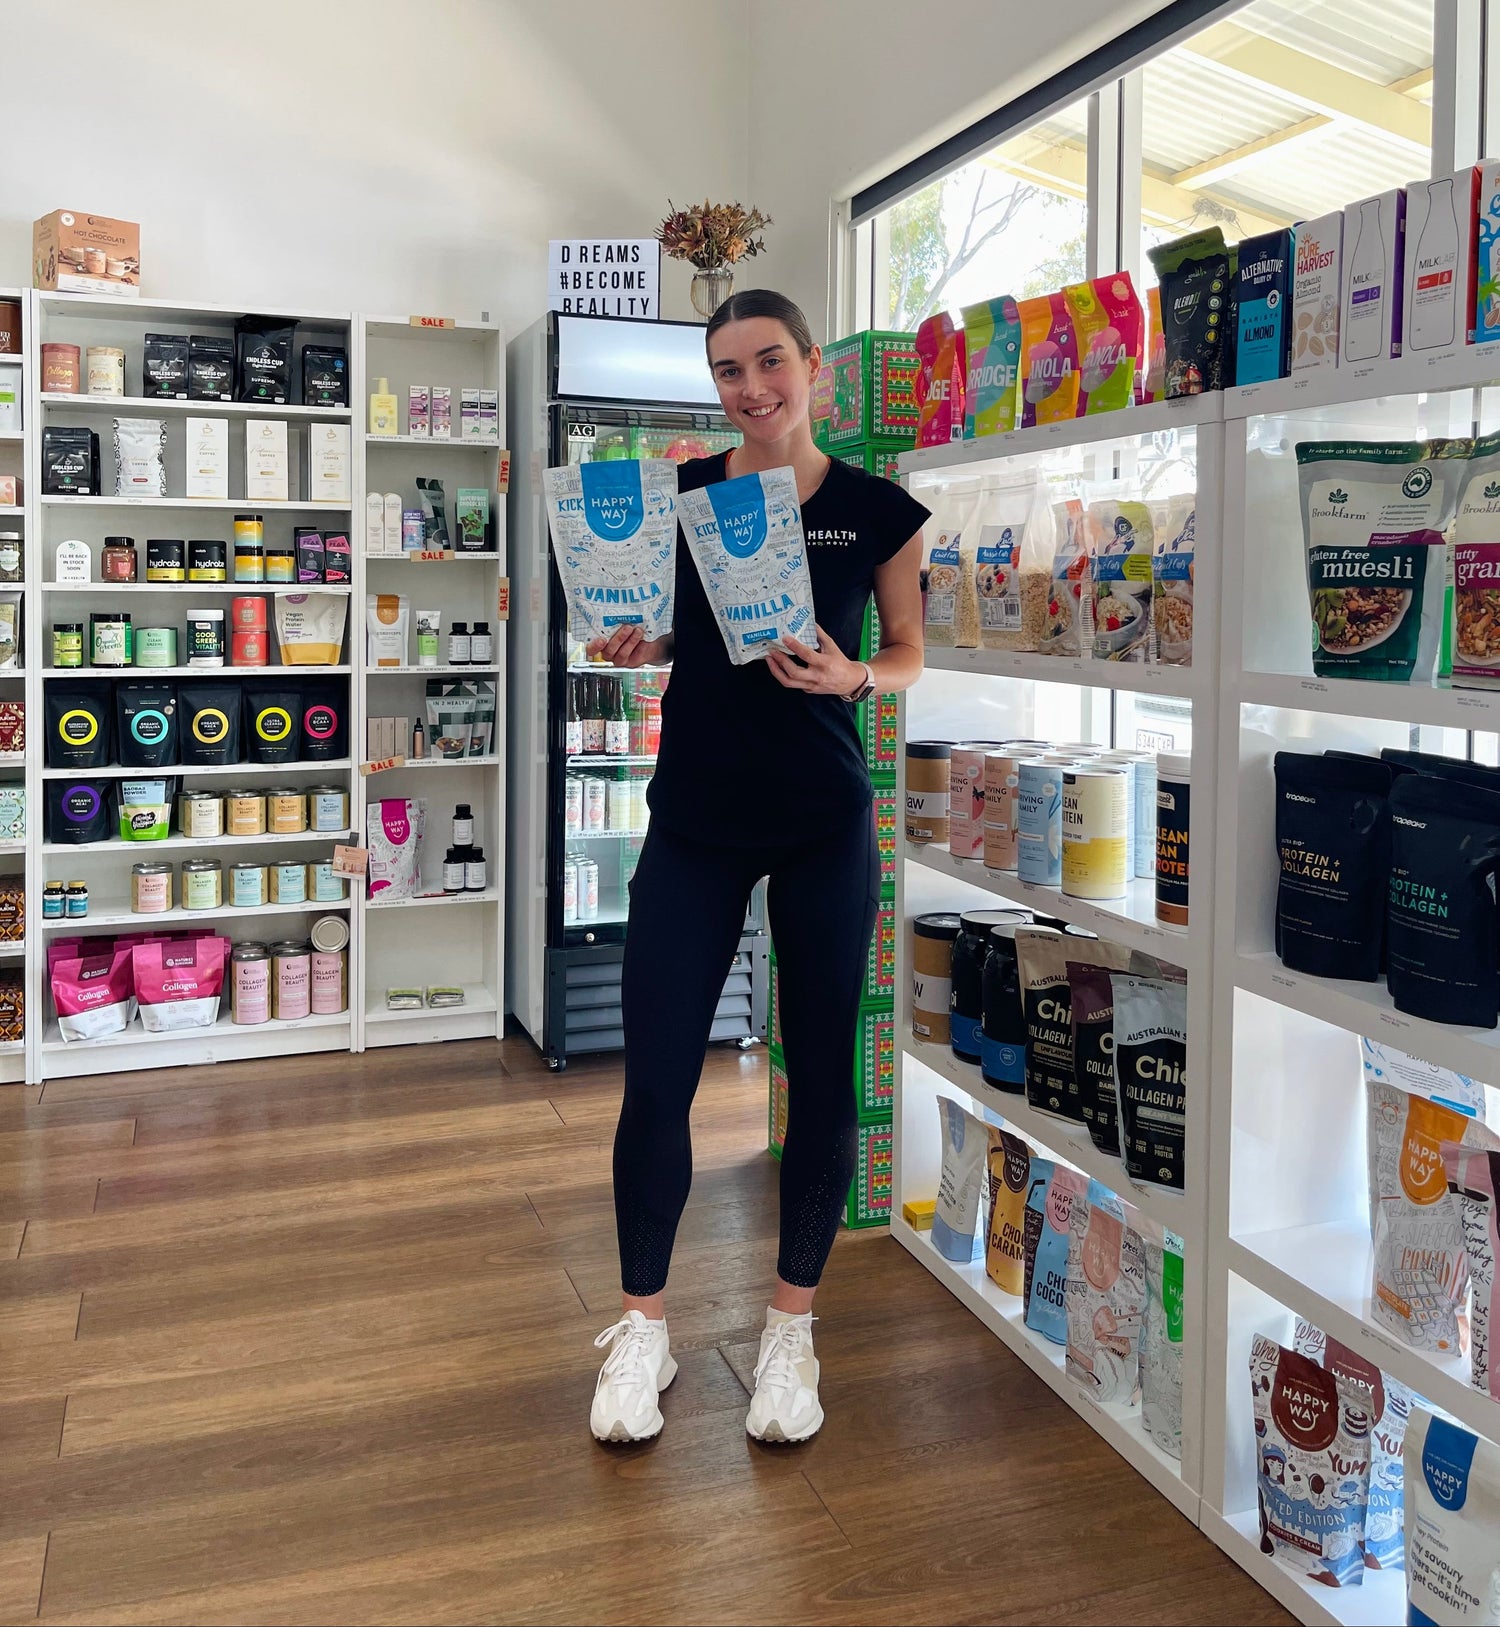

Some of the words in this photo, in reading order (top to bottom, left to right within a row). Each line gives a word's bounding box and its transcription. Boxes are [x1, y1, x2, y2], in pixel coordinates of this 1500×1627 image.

[73, 230, 86, 238] HOT
[88, 232, 126, 244] CHOCOLATE
[1298, 240, 1320, 261] PURE
[1297, 250, 1335, 276] HARVEST
[1419, 252, 1456, 270] MILKLAB
[1241, 259, 1284, 281] ALTERNATIVE
[560, 271, 646, 289] #BECOME
[1296, 276, 1321, 290] Organic
[1296, 285, 1321, 299] Almond
[563, 298, 650, 316] REALITY
[421, 318, 444, 327] SALE
[1242, 313, 1278, 325] BARISTA
[1244, 324, 1275, 342] ALMOND
[246, 357, 270, 365] ENDLESS
[571, 425, 593, 436] AG
[500, 460, 509, 483] SALE
[558, 498, 584, 512] KICK
[592, 495, 634, 507] HAPPY
[601, 508, 628, 519] WAY
[724, 510, 759, 529] HAPPY
[1312, 506, 1366, 520] Brookfarm
[694, 521, 720, 539] KICK
[734, 525, 754, 538] WAY
[808, 530, 856, 541] HEALTH
[421, 551, 444, 560] SALE
[1341, 551, 1370, 560] free
[150, 560, 181, 569] hydrate
[195, 560, 224, 569] hydrate
[1322, 556, 1414, 580] muesli
[500, 588, 508, 611] SALE
[583, 583, 662, 604] VANILLA
[726, 593, 794, 621] VANILLA
[788, 605, 811, 634] GANGSTER
[746, 630, 771, 640] VANILLA
[371, 759, 394, 772] SALE
[906, 795, 925, 810] aw
[385, 819, 406, 828] HAPPY
[1157, 830, 1188, 844] LEAN
[1157, 845, 1178, 859] EAN
[1441, 892, 1448, 901] +
[162, 981, 198, 992] Collagen
[78, 988, 110, 1002] Collagen
[1028, 1024, 1066, 1043] COLLAGEN
[1126, 1027, 1180, 1042] AUSTRALIAN
[1126, 1083, 1174, 1106] COLLAGEN
[1098, 1116, 1108, 1124] FREE
[1136, 1145, 1146, 1153] FREE
[1154, 1150, 1174, 1159] PROTEIN
[1409, 1138, 1445, 1168] HAPPY
[1006, 1154, 1027, 1169] HAPPY
[1410, 1157, 1435, 1177] WAY
[1010, 1165, 1025, 1176] WAY
[1054, 1201, 1070, 1215] WAY
[1460, 1198, 1486, 1216] Hey
[1036, 1284, 1064, 1307] COCO
[1295, 1321, 1326, 1353] Whey
[1253, 1340, 1279, 1370] Whey
[1282, 1385, 1329, 1412] HAPPY
[1290, 1404, 1319, 1422] WAY
[1328, 1451, 1367, 1475] YUM
[1426, 1463, 1463, 1489] HAPPY
[1433, 1477, 1455, 1494] WAY
[1298, 1510, 1345, 1527] EDITION
[1300, 1538, 1321, 1551] CREAM
[1427, 1533, 1449, 1552] Protein
[1424, 1549, 1464, 1583] savoury
[1413, 1571, 1426, 1587] get
[1427, 1581, 1468, 1615] cookin'!
[1455, 1584, 1481, 1607] time
